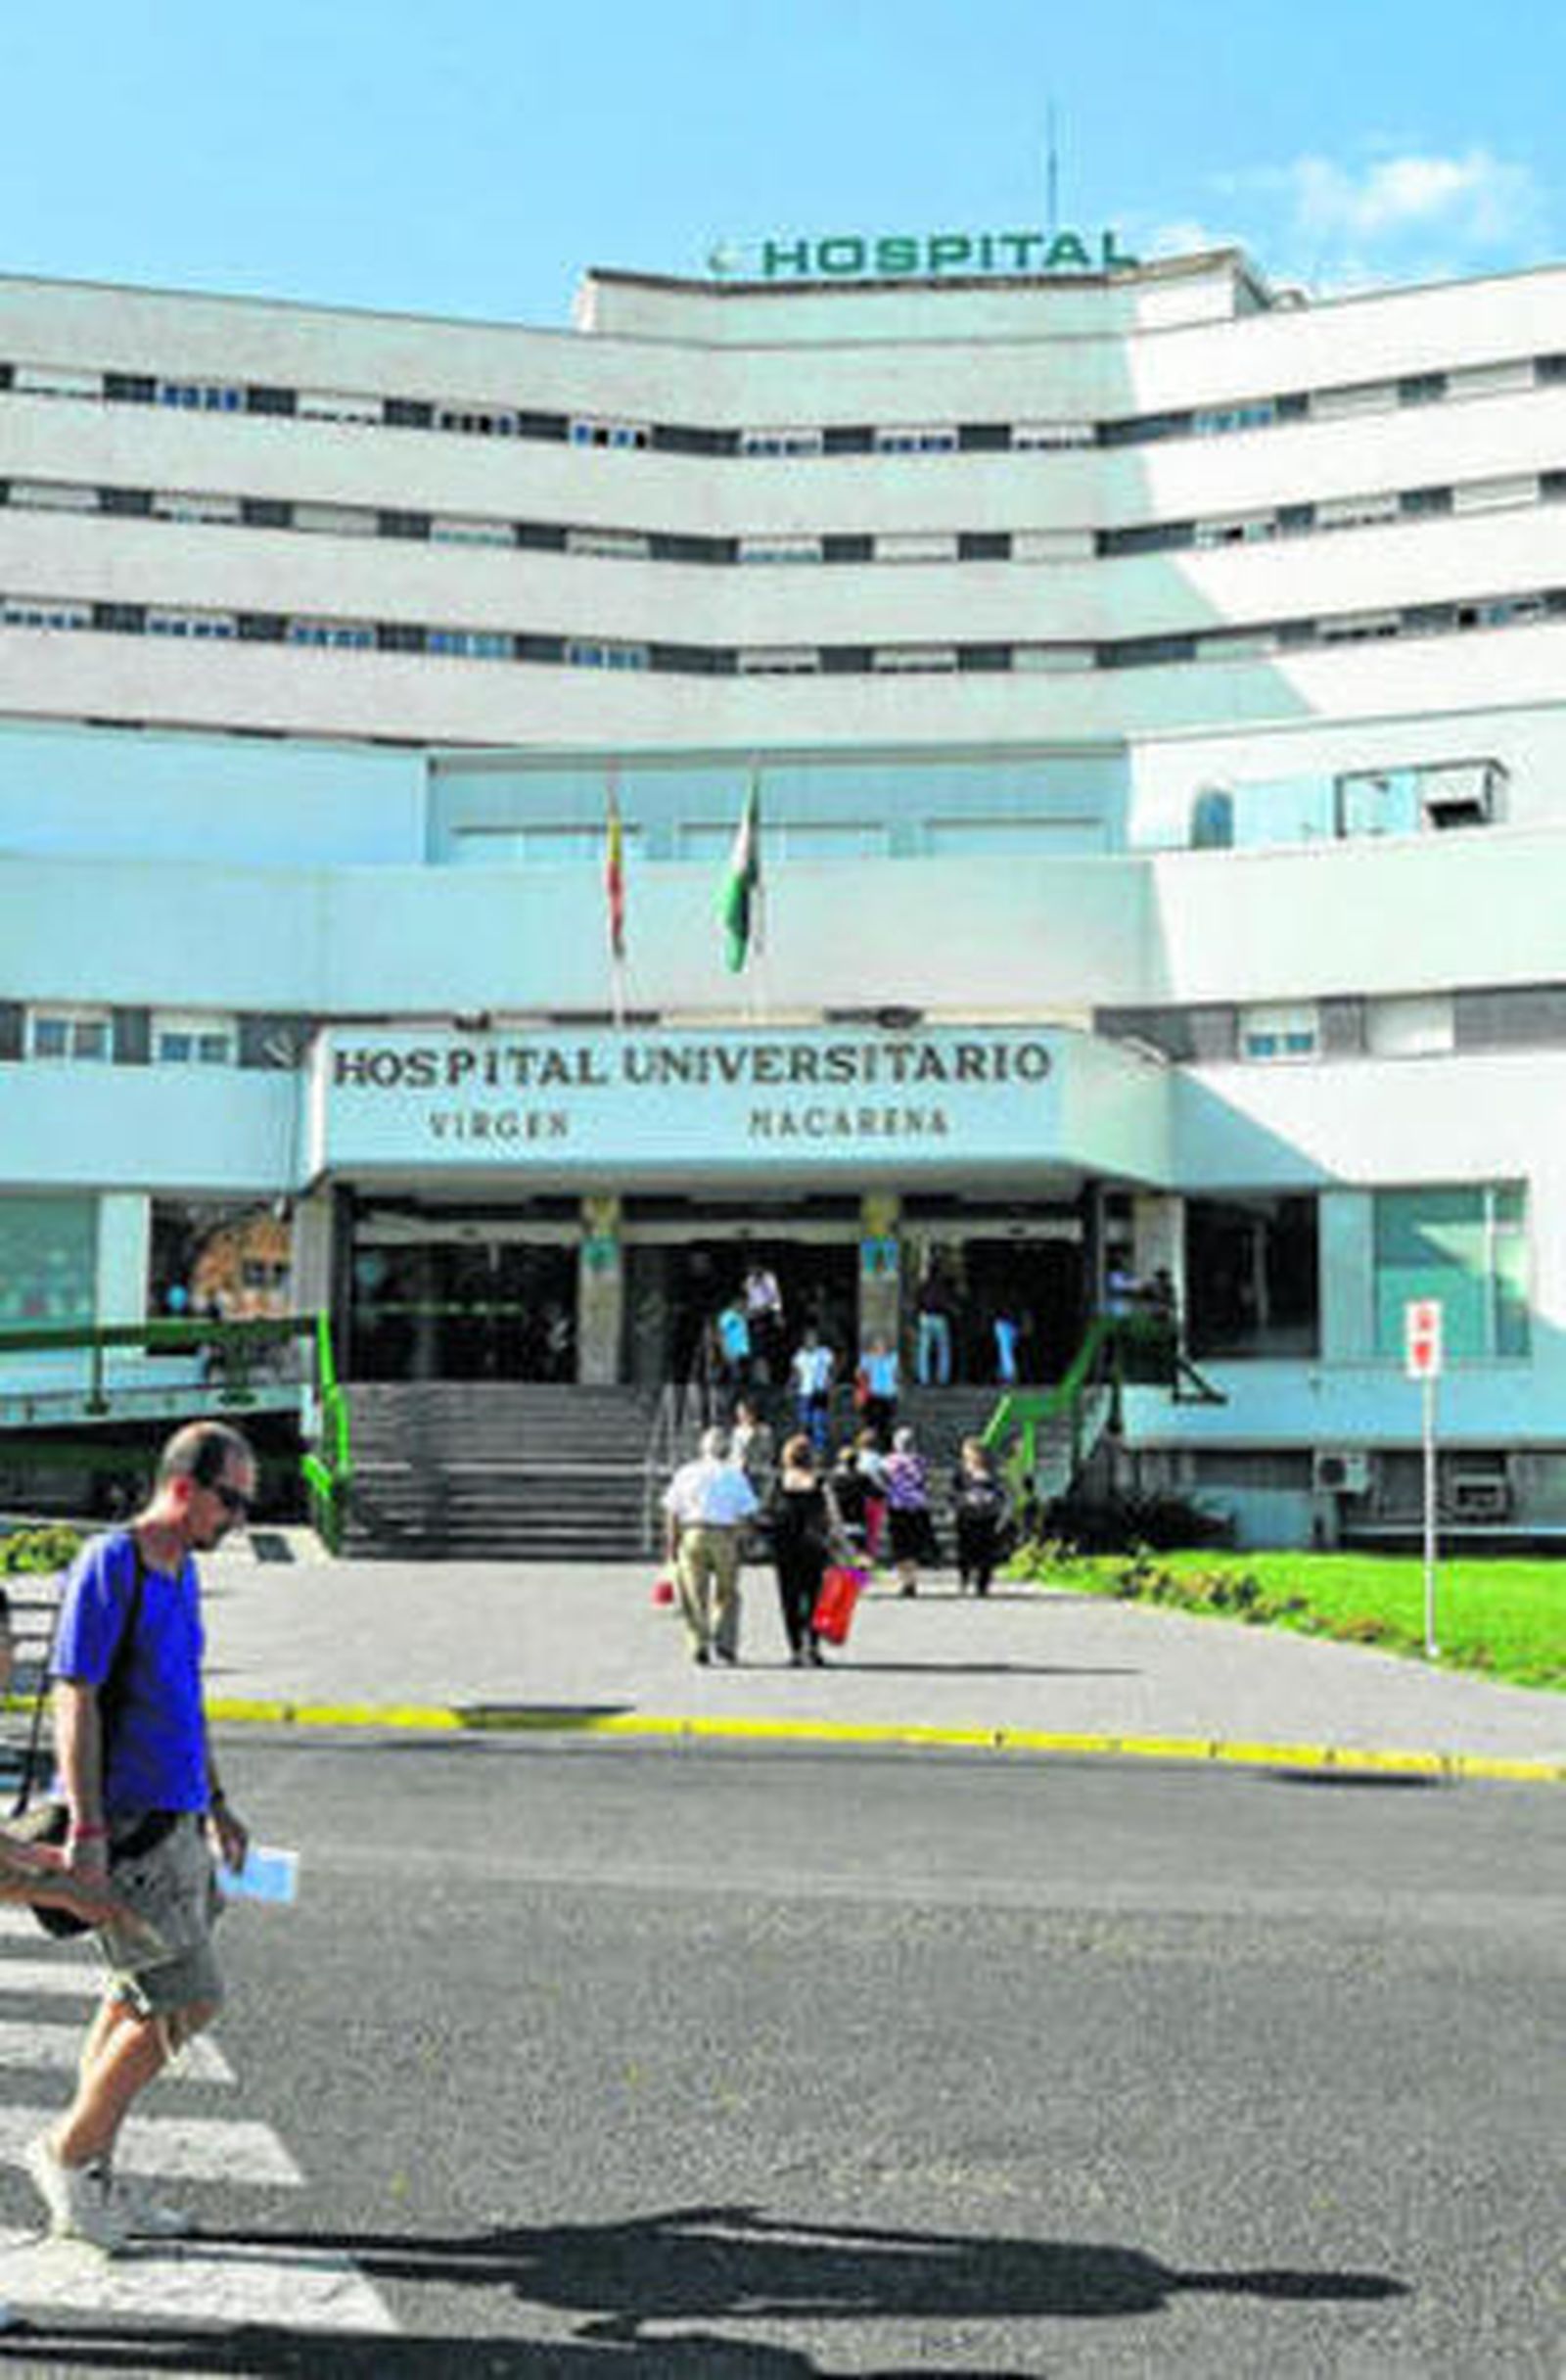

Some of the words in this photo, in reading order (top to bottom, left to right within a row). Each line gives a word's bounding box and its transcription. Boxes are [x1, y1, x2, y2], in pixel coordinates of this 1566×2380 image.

[763, 231, 1138, 275] HOSPITAL
[333, 1048, 608, 1086] HOSPITAL
[622, 1043, 1051, 1083] UNIVERSITARIO
[431, 1111, 568, 1138] VIRGEN
[749, 1108, 947, 1137] MACARENA
